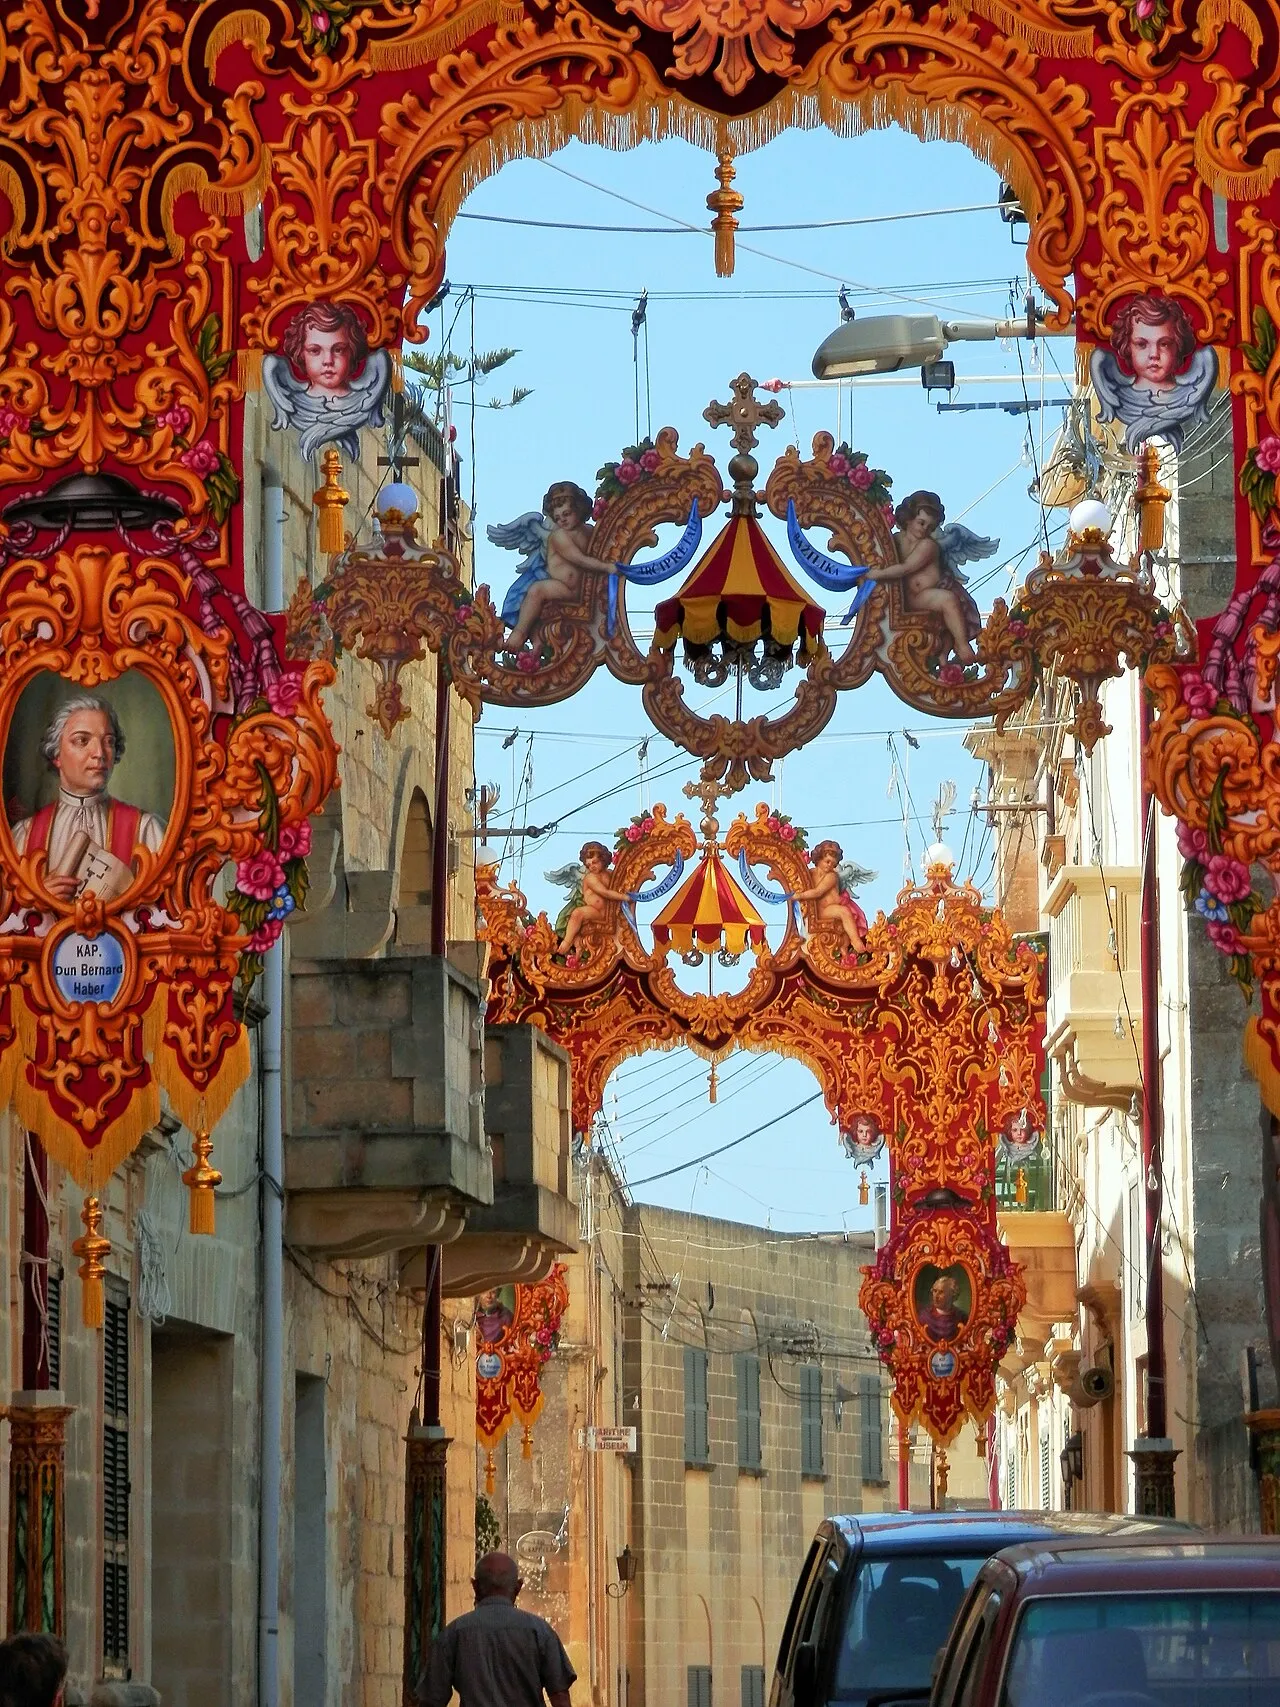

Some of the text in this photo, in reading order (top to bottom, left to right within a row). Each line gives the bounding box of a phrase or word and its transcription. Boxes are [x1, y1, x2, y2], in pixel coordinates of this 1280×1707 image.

[76, 944, 102, 958] KAP.
[55, 964, 123, 976] Dun Bernard
[73, 982, 105, 996] Haber
[595, 1441, 629, 1450] MUSEUM
